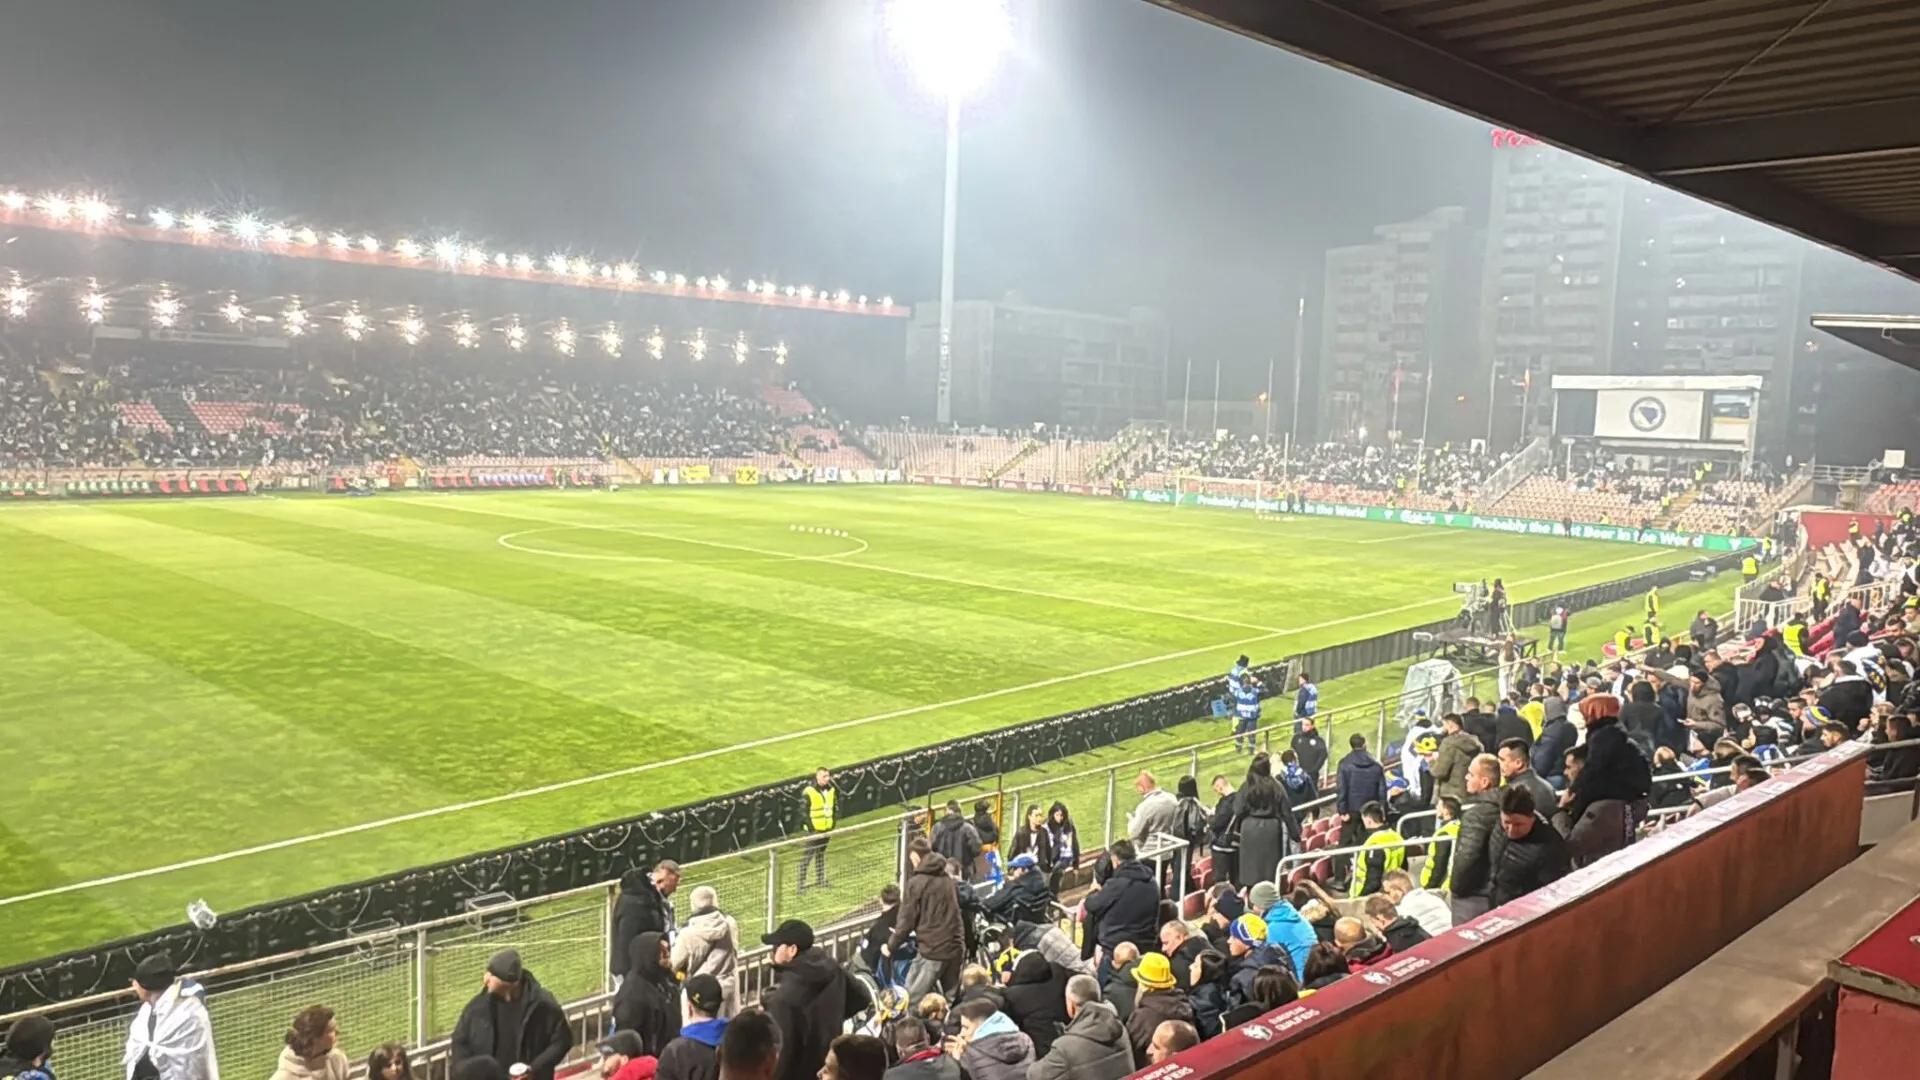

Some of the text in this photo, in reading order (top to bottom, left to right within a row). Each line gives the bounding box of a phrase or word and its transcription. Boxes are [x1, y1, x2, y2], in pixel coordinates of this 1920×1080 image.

[1472, 516, 1528, 533] Probably
[1529, 521, 1551, 533] the
[1552, 522, 1582, 537] Bst
[1583, 525, 1616, 540] Beer
[1660, 531, 1704, 548] Word
